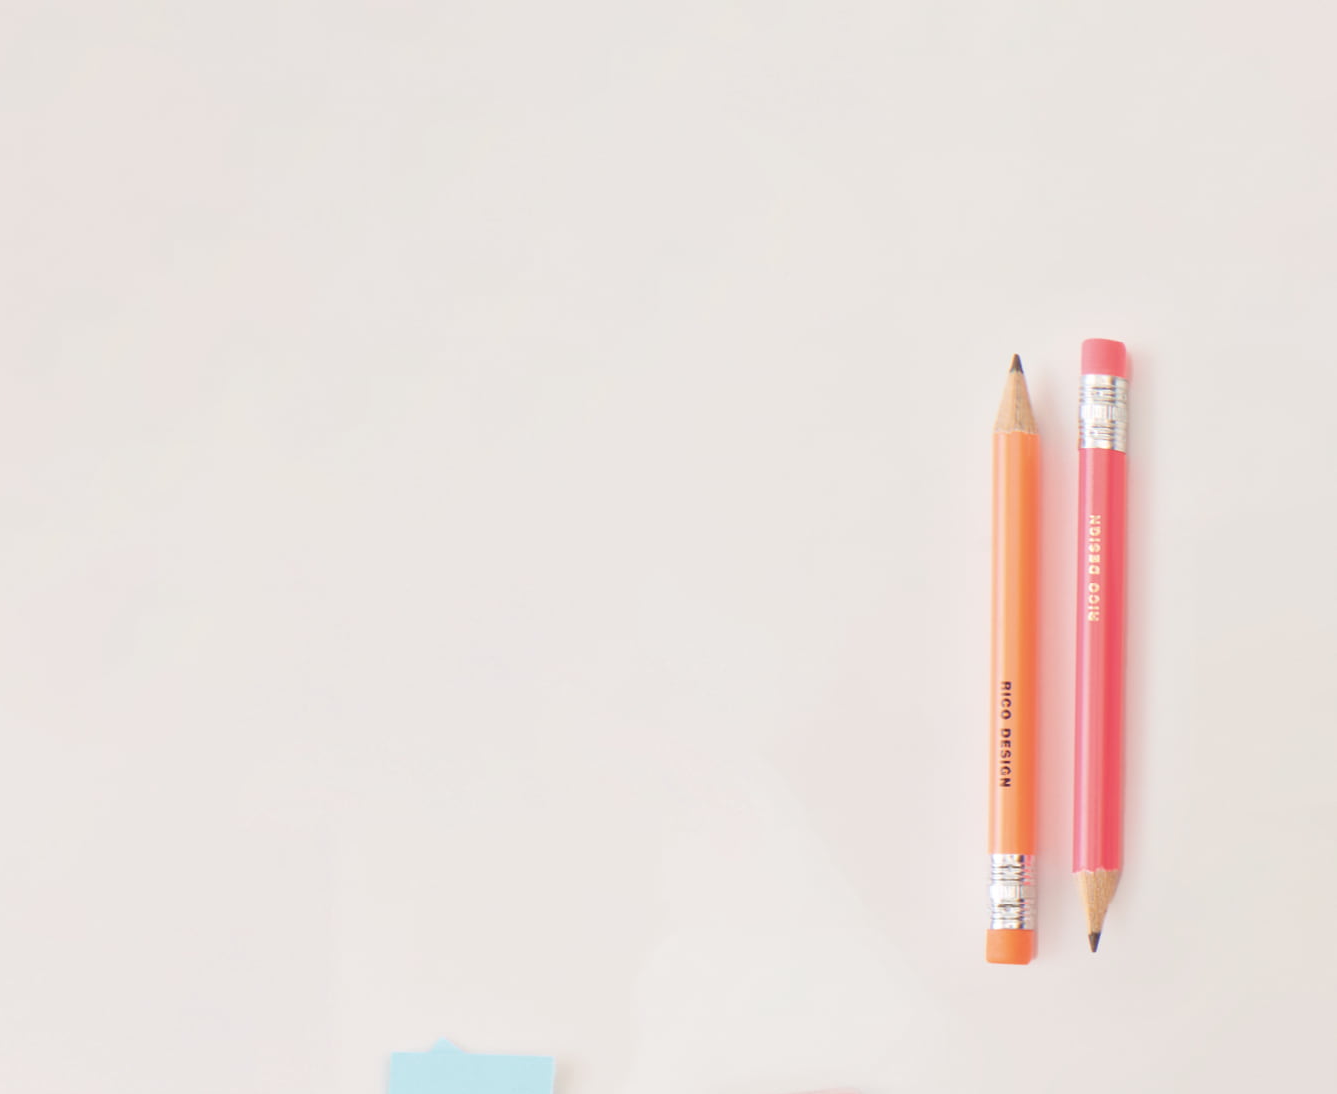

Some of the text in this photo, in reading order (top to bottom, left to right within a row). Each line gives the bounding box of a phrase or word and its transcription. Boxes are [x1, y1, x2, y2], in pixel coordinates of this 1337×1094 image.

[1087, 514, 1102, 621] RICO DESIGN
[999, 681, 1012, 787] RICO DESIGN
